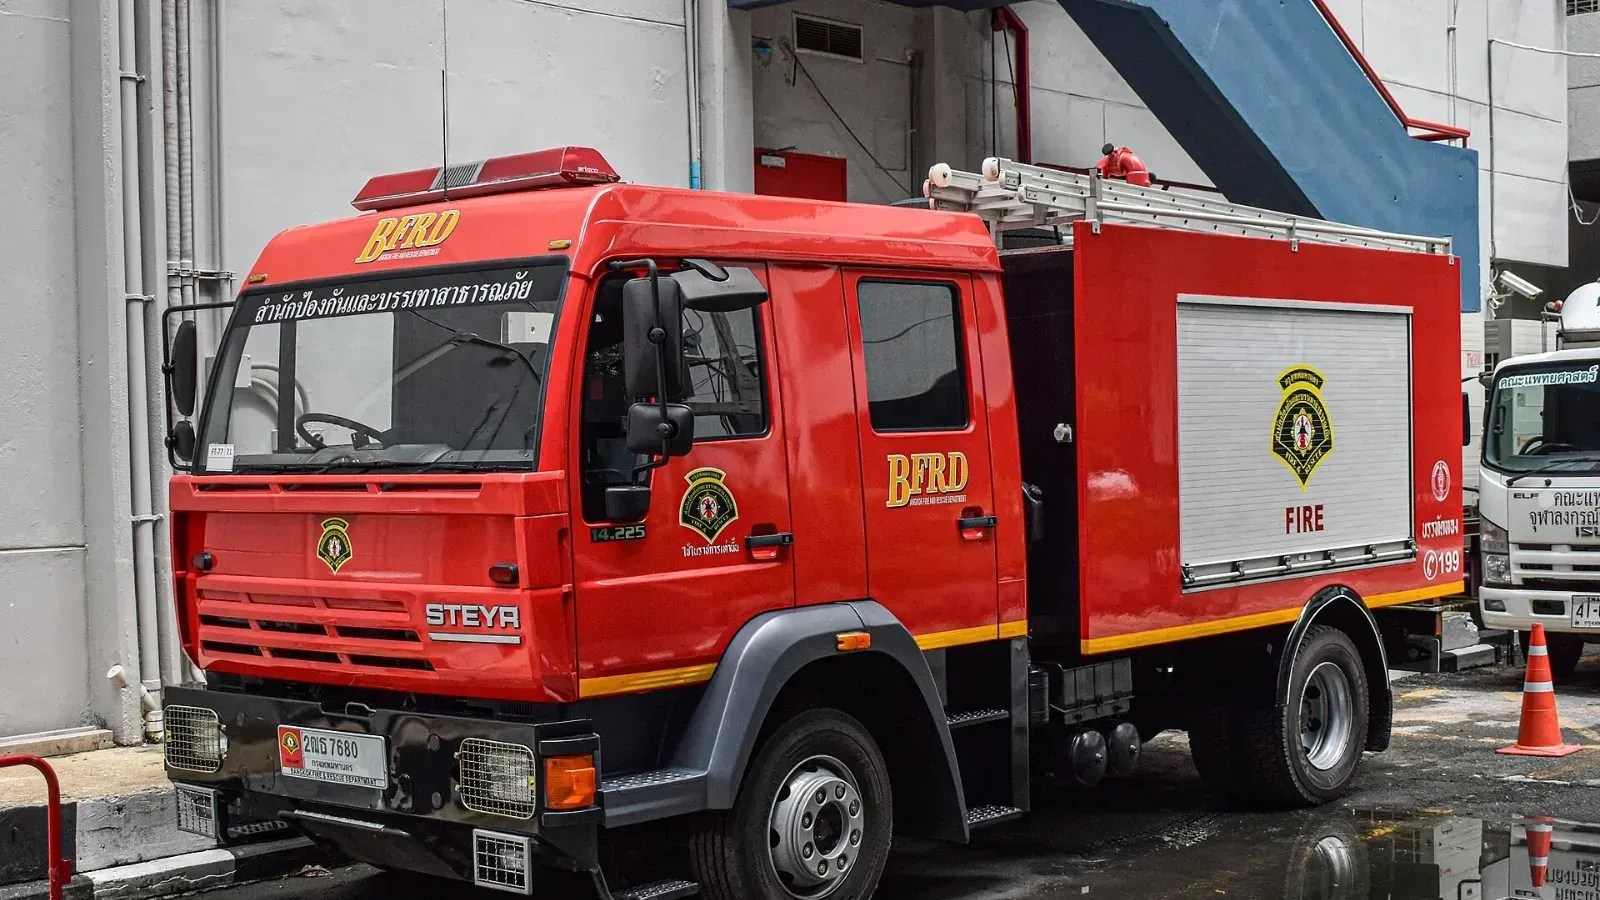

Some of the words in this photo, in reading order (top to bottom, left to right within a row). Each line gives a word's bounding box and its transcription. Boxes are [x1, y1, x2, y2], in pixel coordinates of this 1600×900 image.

[354, 209, 461, 264] BFRD
[255, 270, 534, 323] สำนักป้องกันและบรรเทาสาธารณภัย
[1499, 365, 1599, 390] คณะแพทยศาสตร์
[886, 451, 969, 508] BFRD
[1285, 504, 1324, 535] FIRE
[591, 525, 646, 541] 14.225
[1438, 549, 1460, 574] 199
[425, 603, 521, 629] STEYR
[329, 737, 359, 759] 7680
